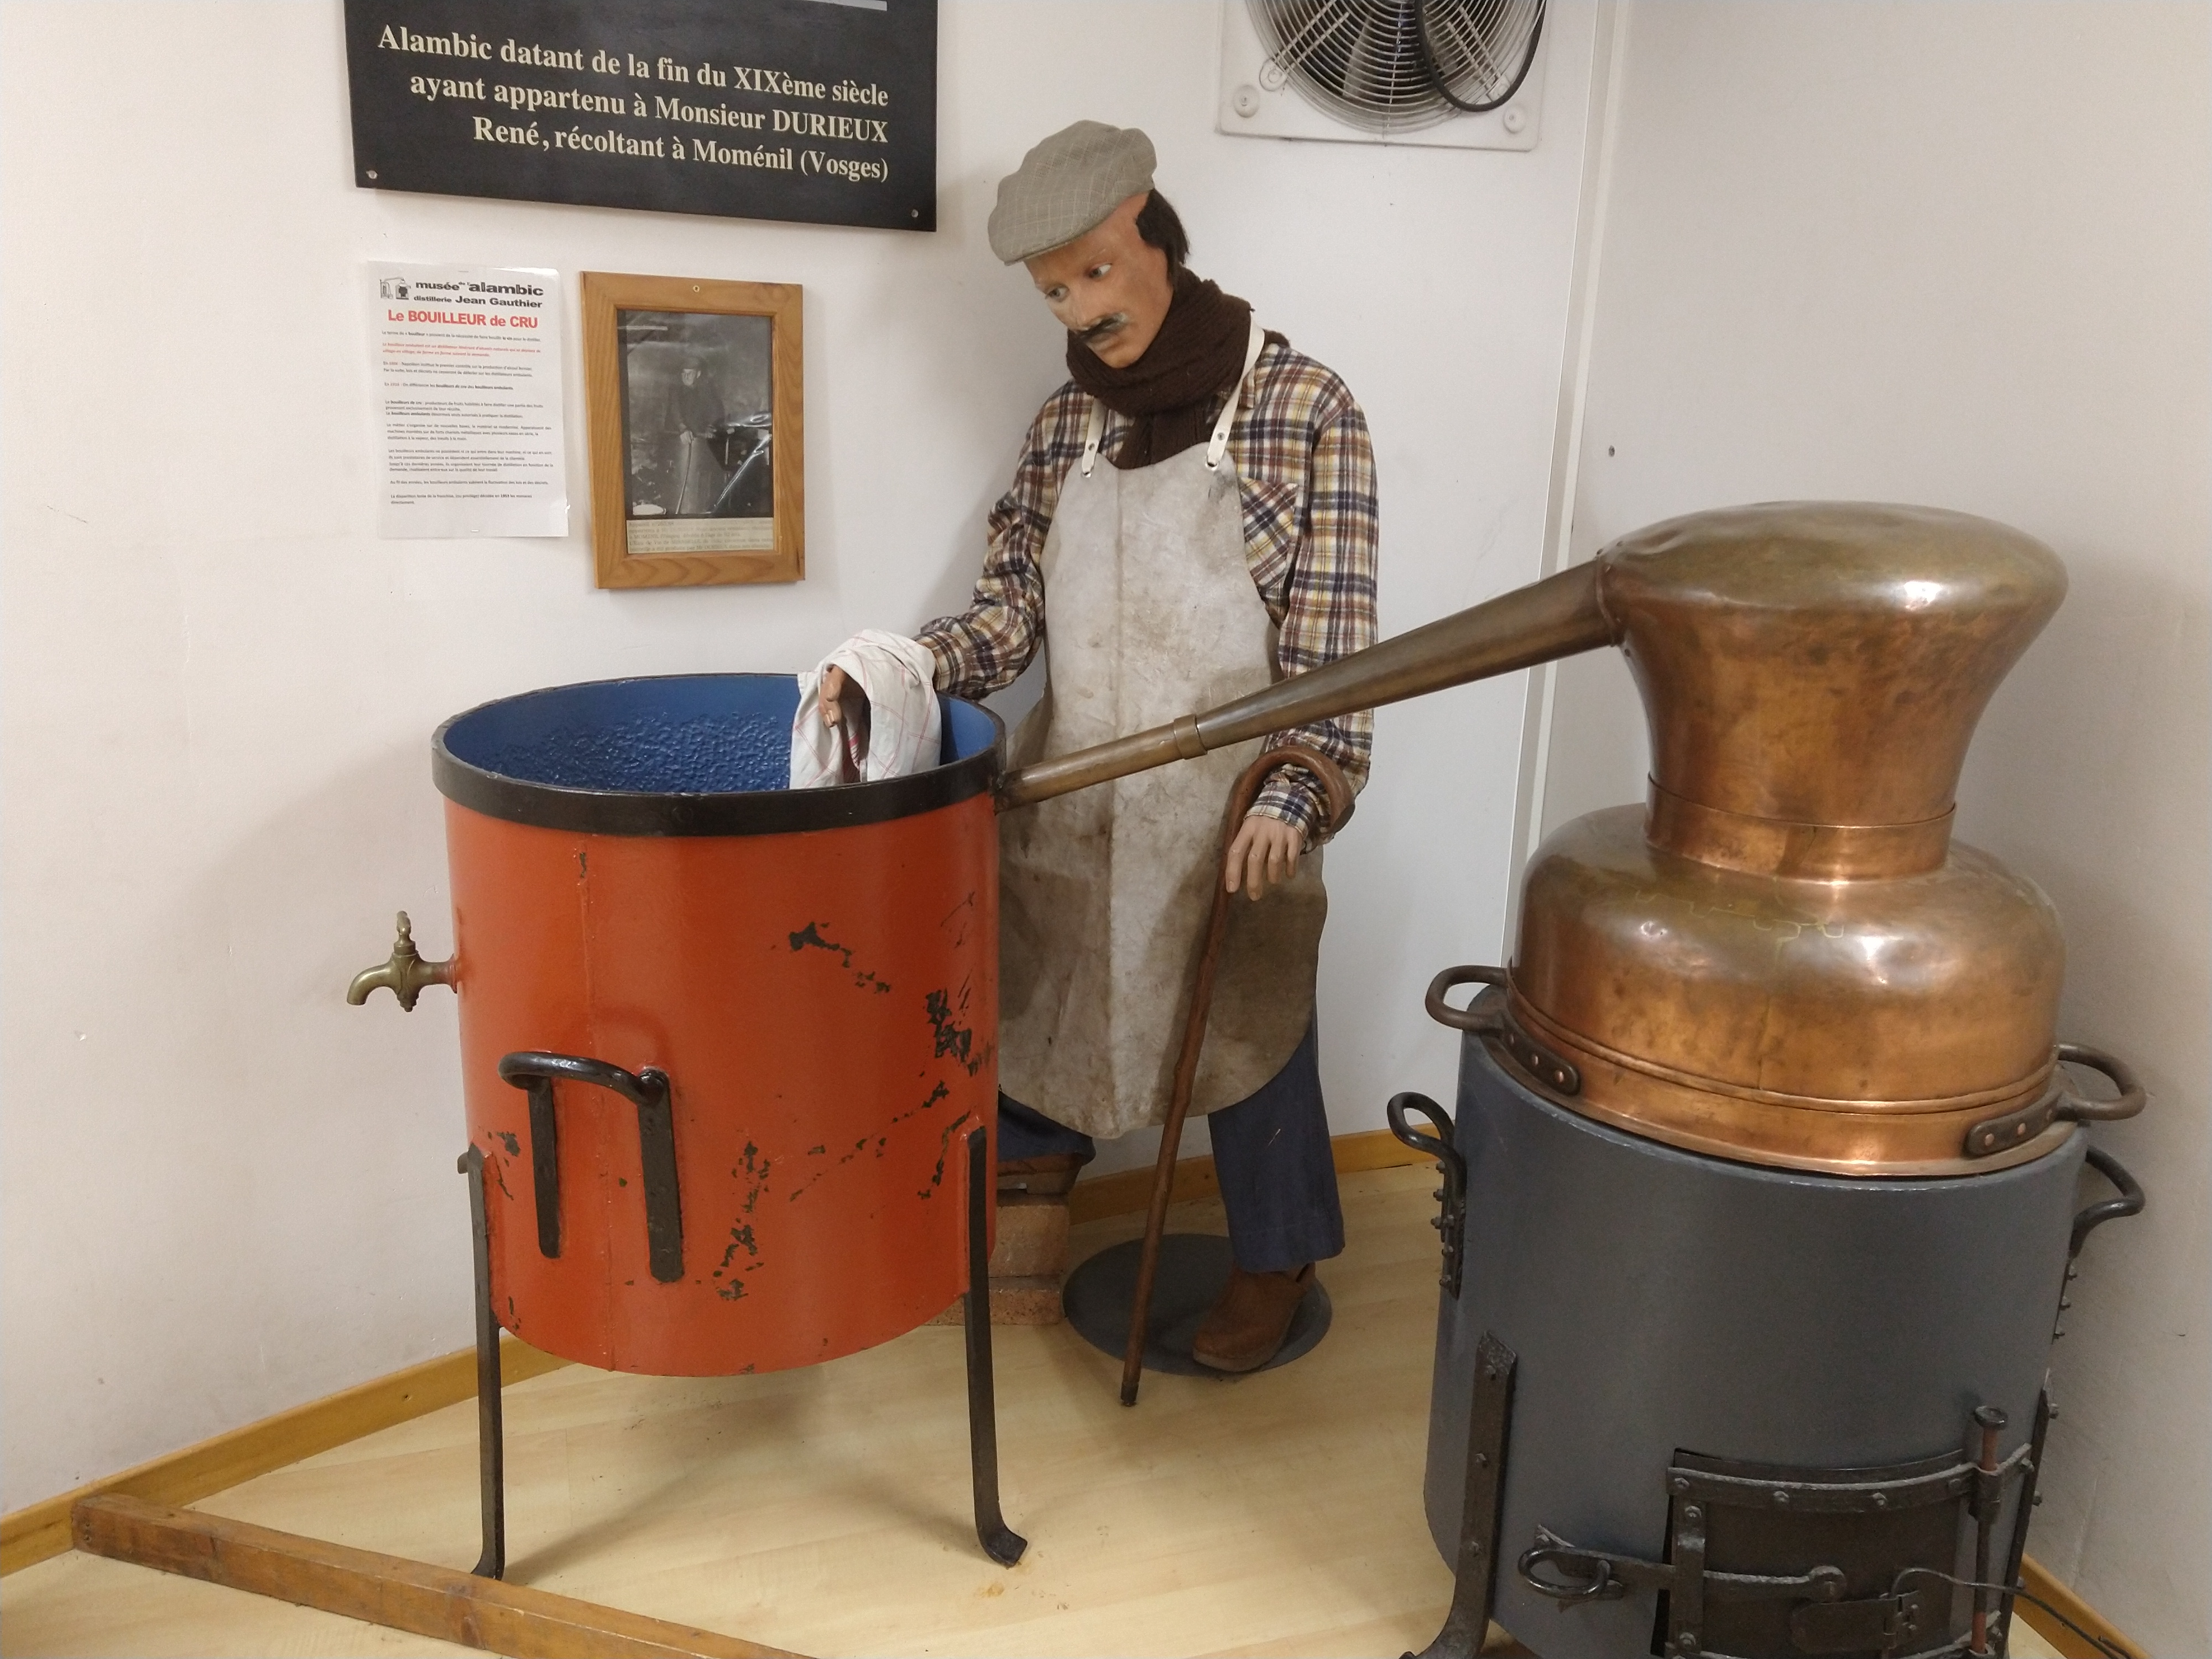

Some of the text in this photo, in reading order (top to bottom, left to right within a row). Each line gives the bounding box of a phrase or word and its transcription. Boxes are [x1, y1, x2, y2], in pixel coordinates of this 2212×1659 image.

[378, 25, 888, 106] Alambic datant de la fin du XIXème siècle
[410, 76, 888, 143] ayant appartenu à Monsieur DURIEUX
[472, 117, 888, 182] René, récoltant à Moménil (Vosges)
[416, 281, 460, 291] musée
[455, 295, 486, 305] Jean
[489, 298, 543, 308] Gauthier
[388, 310, 538, 328] Le BOUILLEUR de CRU
